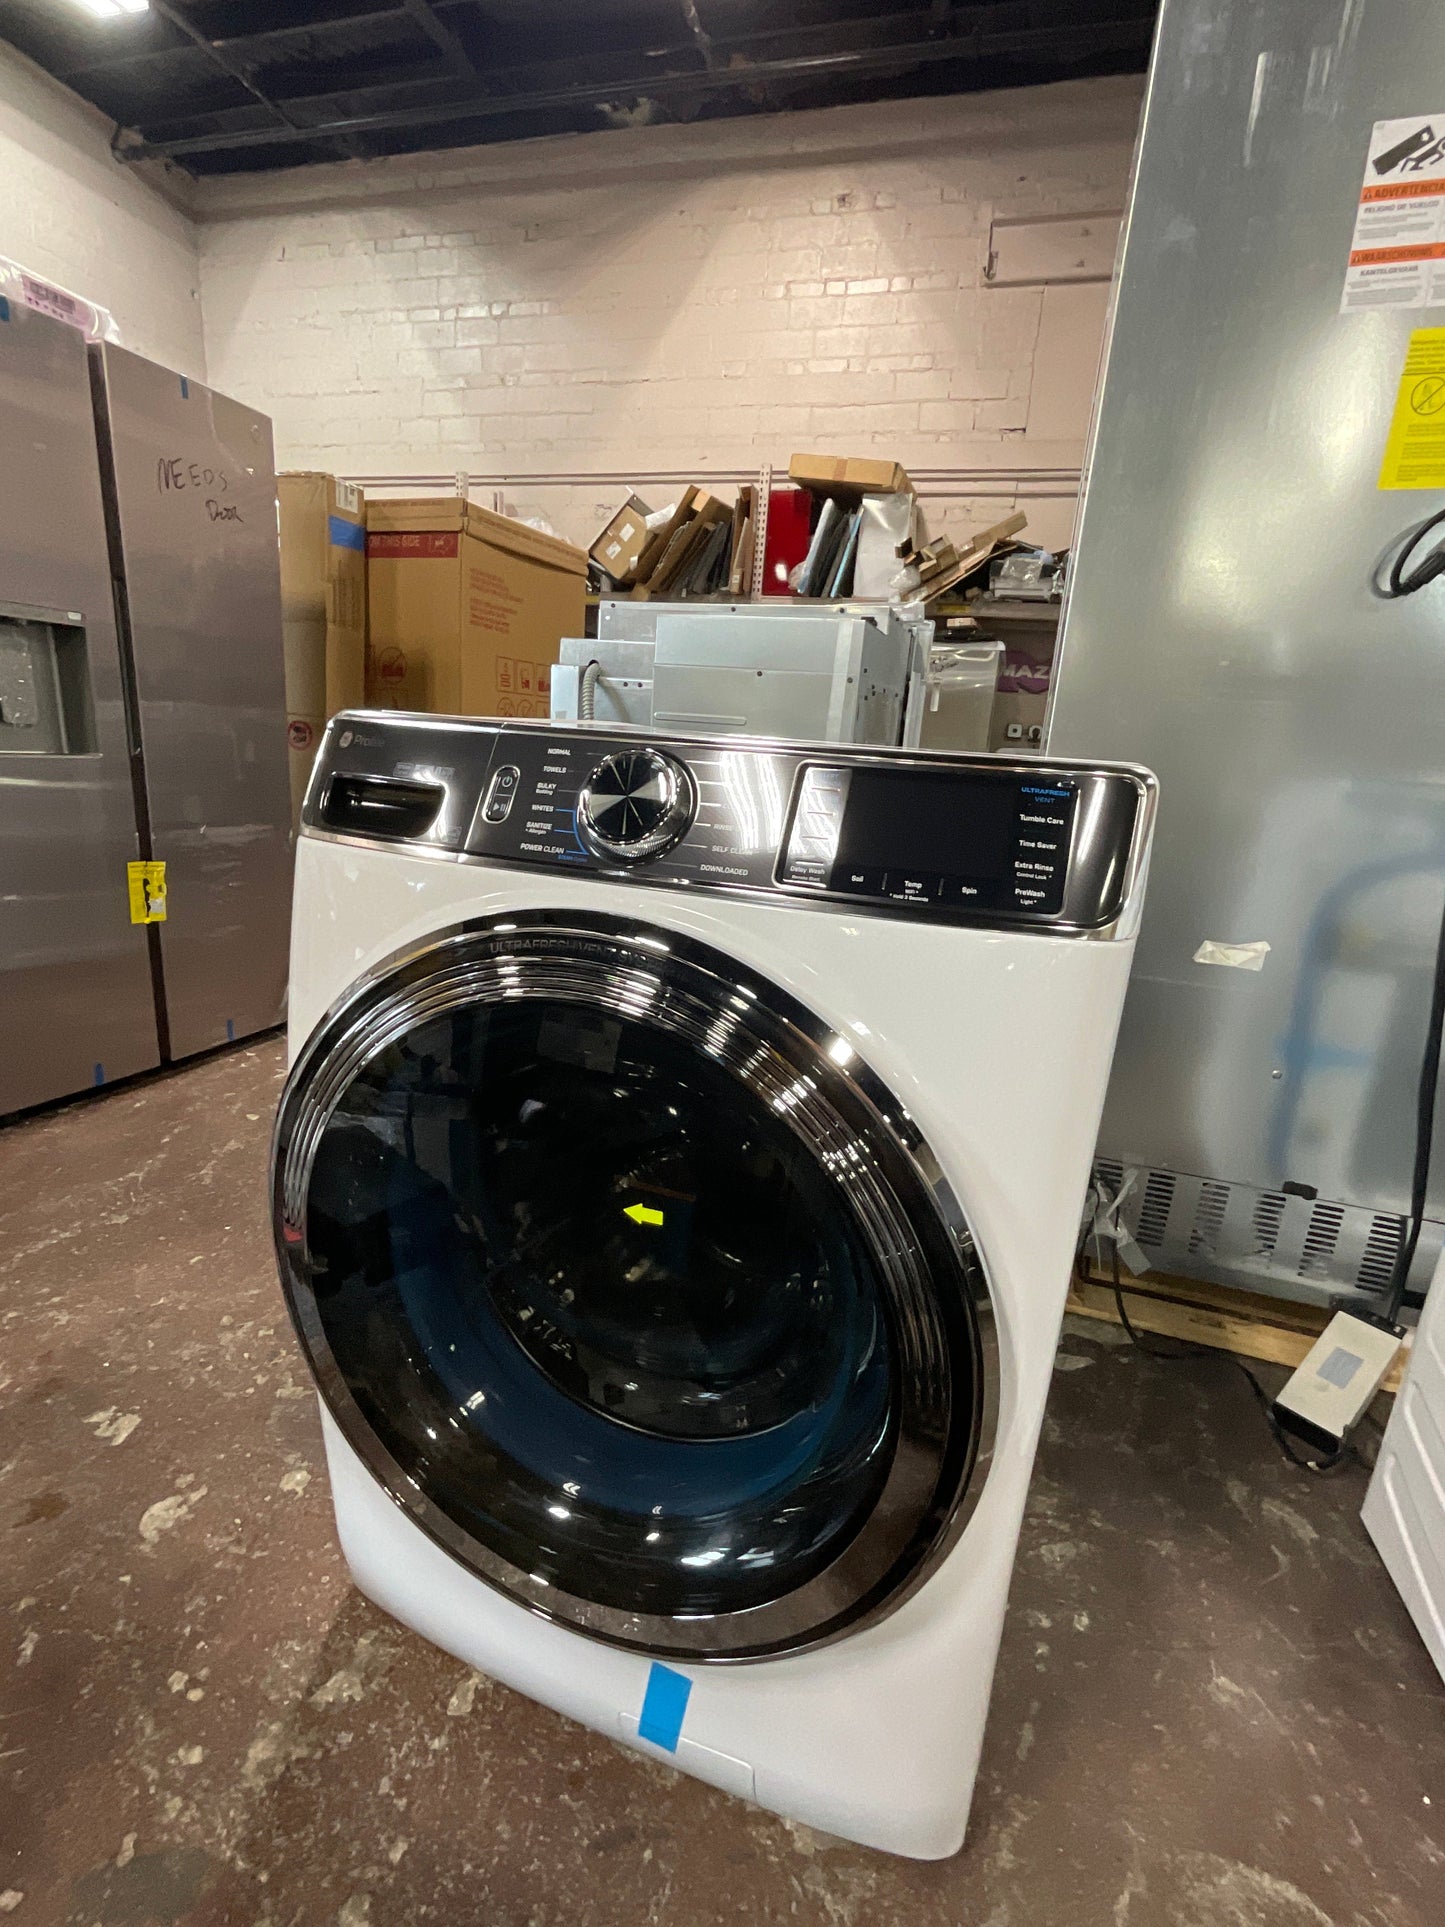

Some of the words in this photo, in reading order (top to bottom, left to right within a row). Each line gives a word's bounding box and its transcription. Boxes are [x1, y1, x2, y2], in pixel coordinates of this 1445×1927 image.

[158, 457, 228, 495] NEEDS
[547, 748, 571, 756] NORMAL
[543, 765, 567, 773] TOWELS
[1021, 786, 1070, 797] ULTRAFRESH
[531, 804, 554, 812] WHITES
[1019, 813, 1046, 823] Tumble
[1047, 816, 1064, 825] Care
[526, 821, 552, 830] SANITIZE
[520, 842, 543, 852] POWER
[543, 845, 565, 854] CLEAN
[711, 844, 729, 854] SELF
[1019, 839, 1036, 848] Time
[1037, 841, 1058, 850] Saver
[700, 863, 748, 876] DOWNLOADED
[790, 865, 807, 874] Delay
[808, 866, 825, 875] Wash
[1014, 861, 1033, 869] Extra
[1034, 863, 1054, 872] Rinse
[851, 874, 864, 883] Soil
[904, 880, 922, 890] Temp
[961, 886, 977, 895] Spin
[1014, 888, 1046, 898] PreWash
